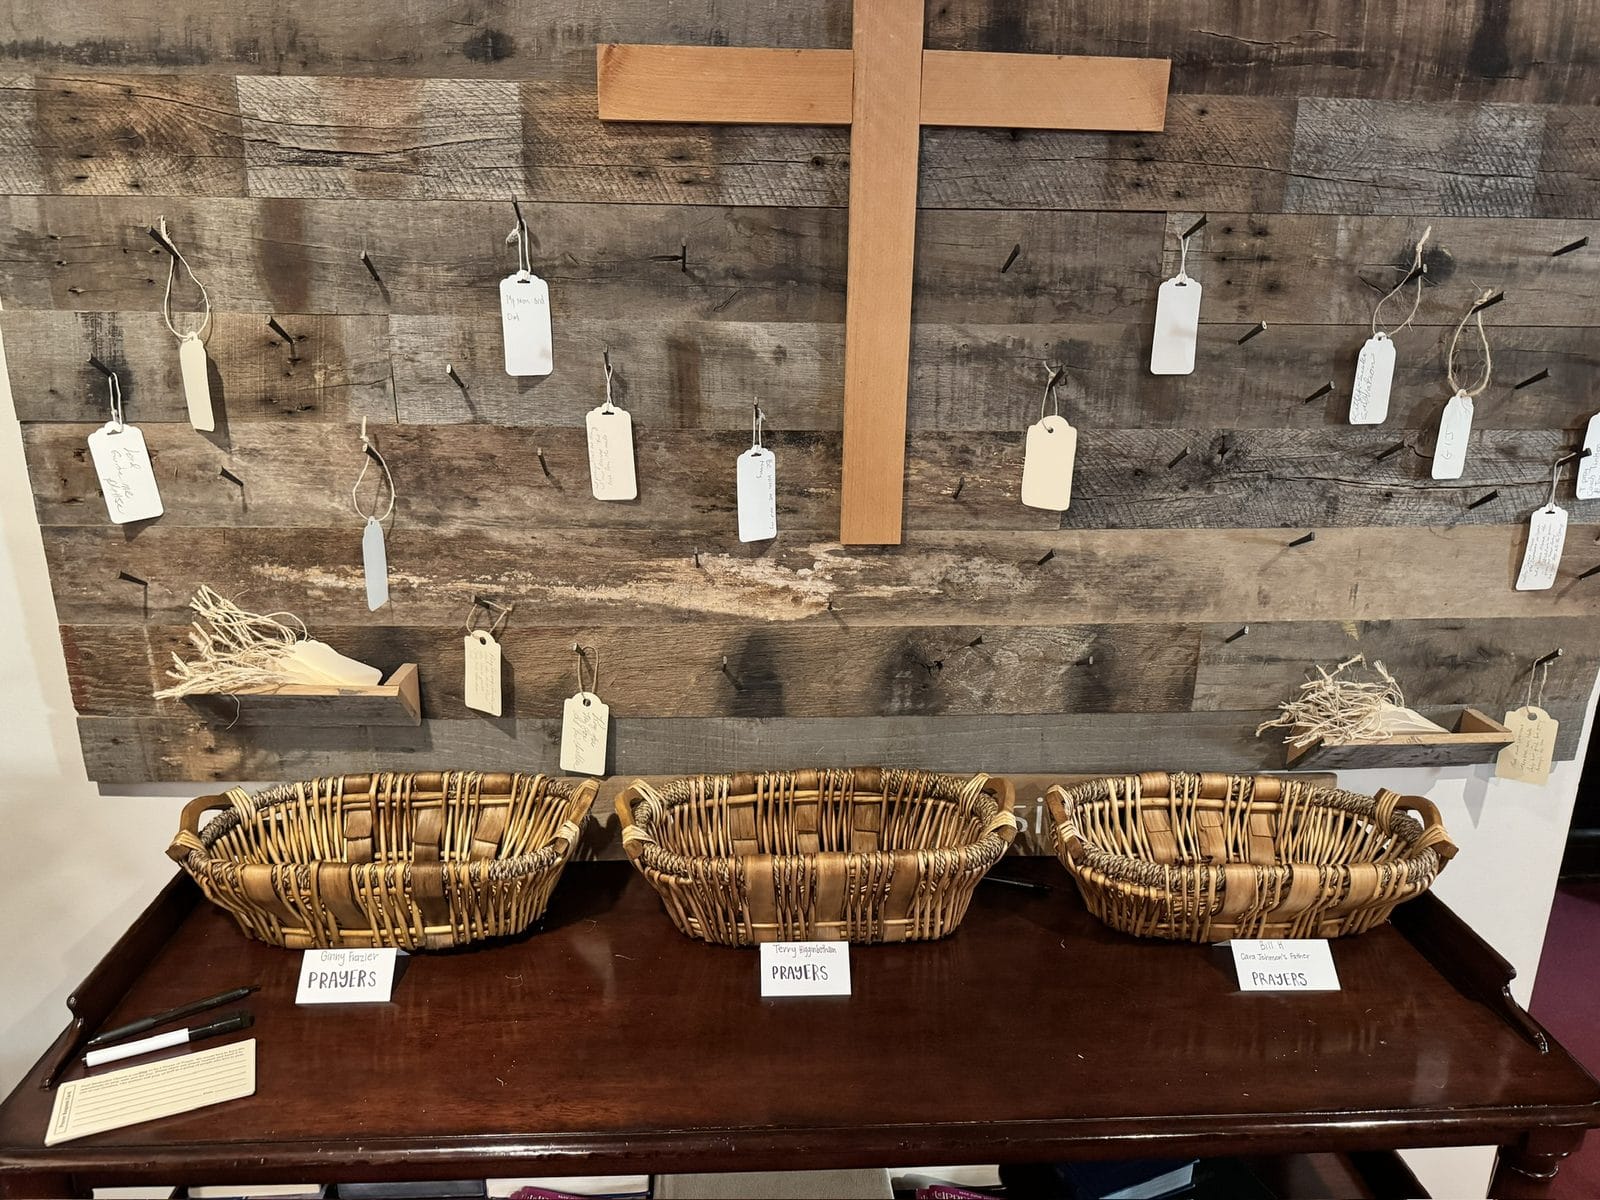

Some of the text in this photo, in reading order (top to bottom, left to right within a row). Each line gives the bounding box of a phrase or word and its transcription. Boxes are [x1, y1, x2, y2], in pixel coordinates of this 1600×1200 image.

[320, 951, 345, 966] Ginny
[772, 944, 797, 958] Terry
[308, 969, 377, 989] PRAYERS
[771, 963, 829, 981] PRAYERS
[1251, 971, 1308, 986] PRAYERS
